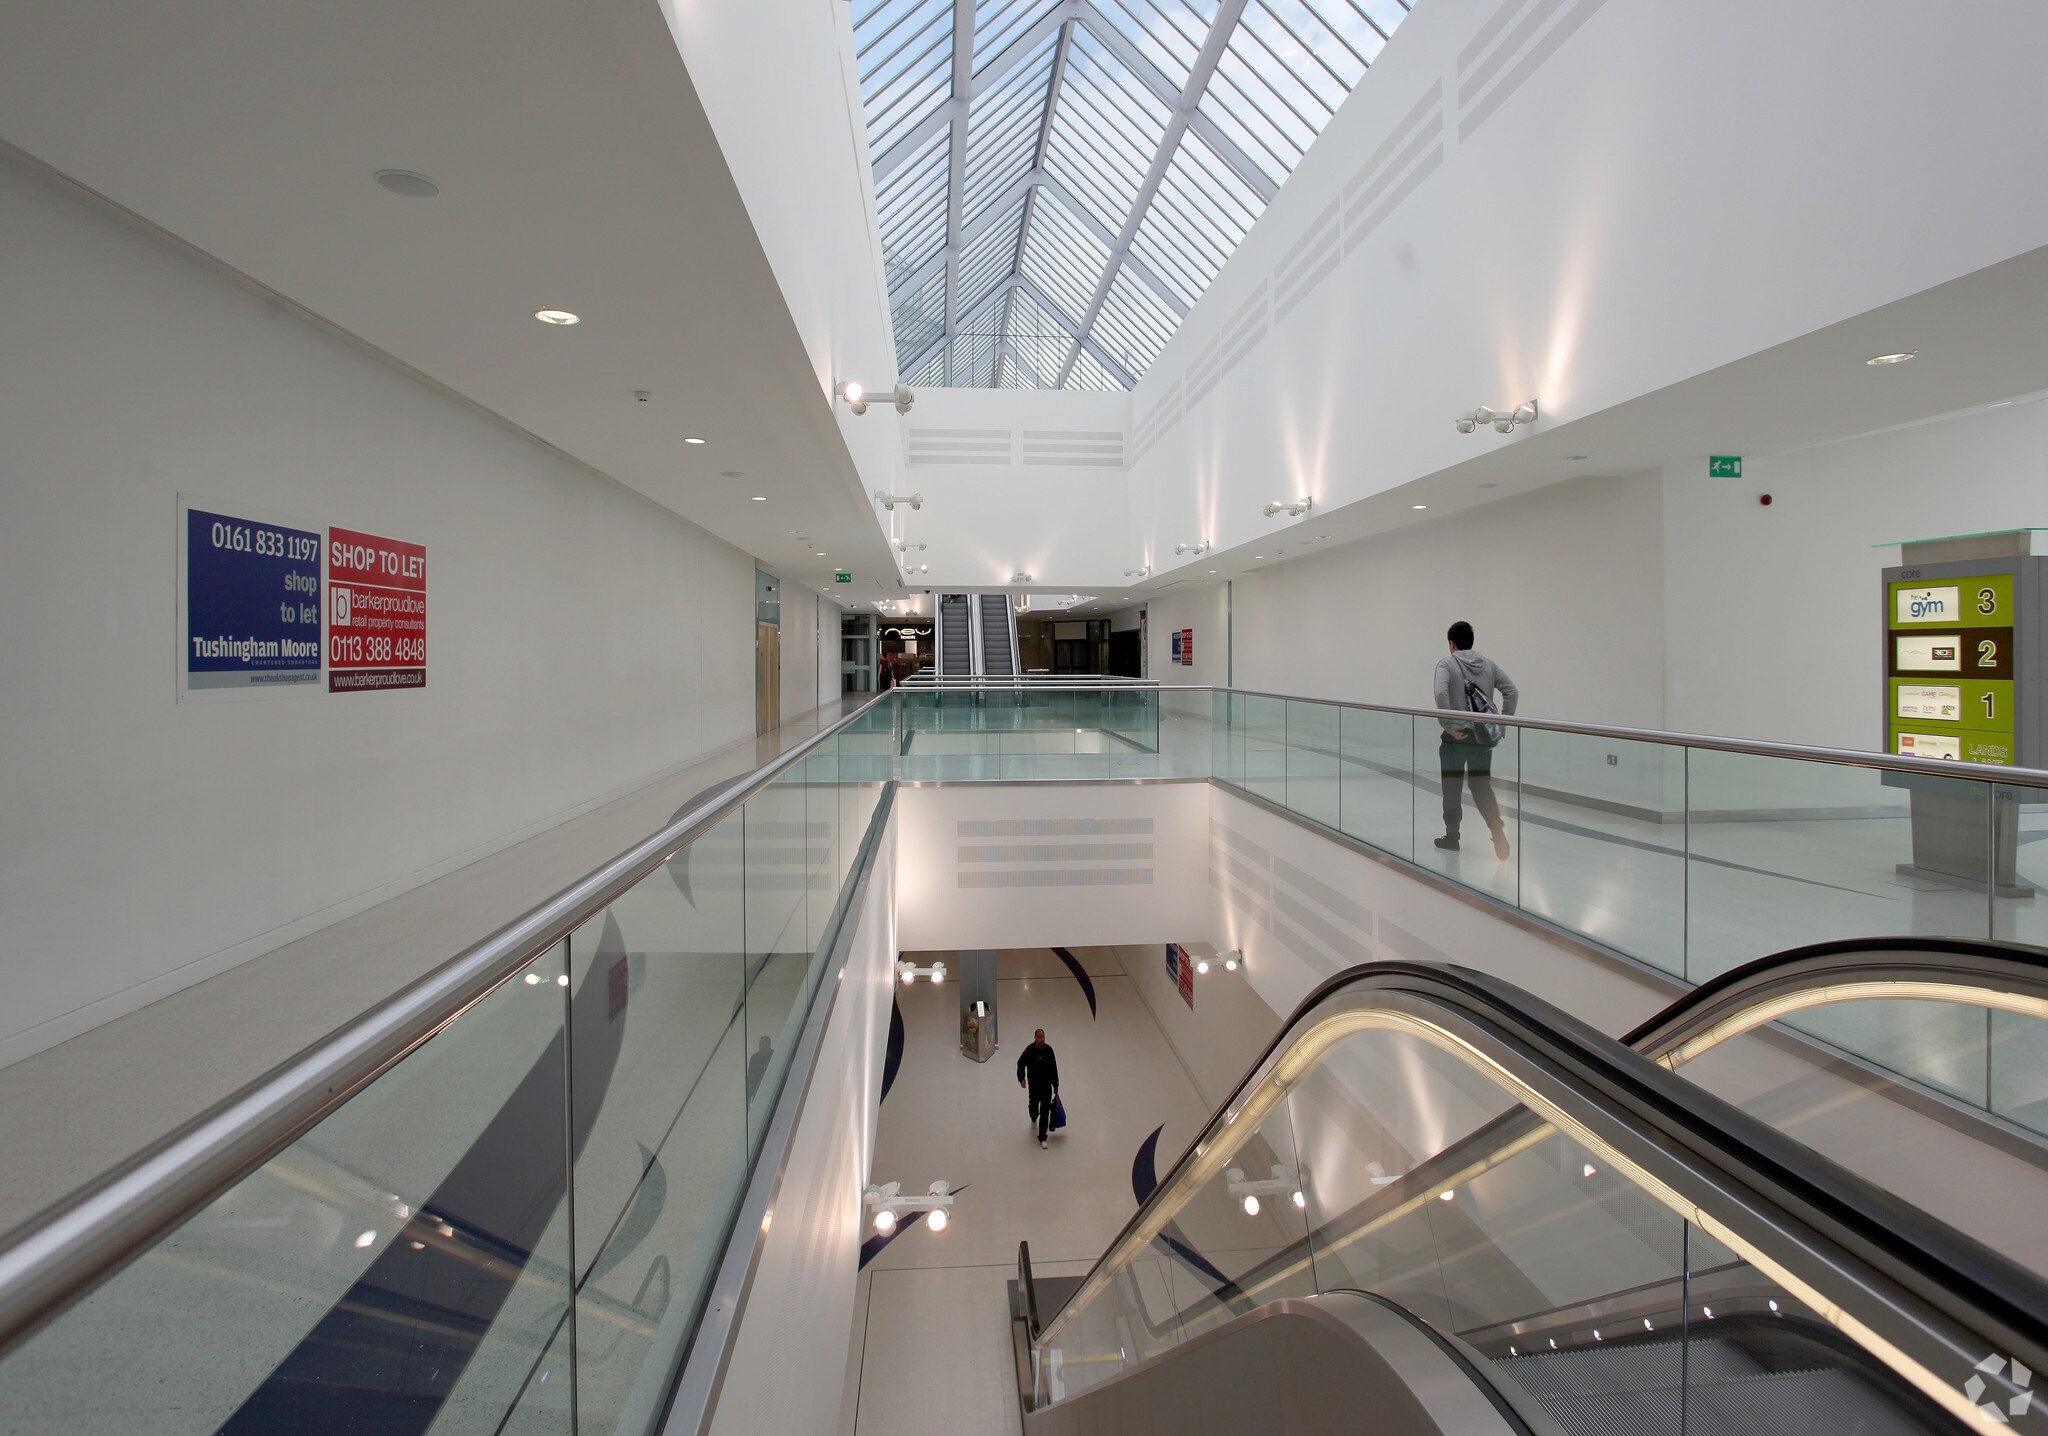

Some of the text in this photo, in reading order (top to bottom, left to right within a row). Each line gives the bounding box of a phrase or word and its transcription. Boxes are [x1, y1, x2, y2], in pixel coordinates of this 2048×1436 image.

[211, 522, 318, 562] 0161 833 1197
[331, 541, 425, 579] SHOP TO LET
[284, 570, 317, 597] shop
[1901, 569, 1921, 579] core
[280, 601, 318, 625] to let
[352, 589, 425, 614] barkerproudlove
[1910, 600, 1944, 618] gym
[1977, 587, 1996, 616] 3
[352, 615, 425, 631] retail property consultants
[192, 635, 318, 662] Tushingham Moore
[331, 635, 425, 662] 0113 388 4848
[1978, 639, 1997, 667] 2
[334, 672, 423, 688] www.barkerproudlove.co.uk
[1980, 691, 1995, 719] 1
[1968, 743, 2008, 758] LANDS
